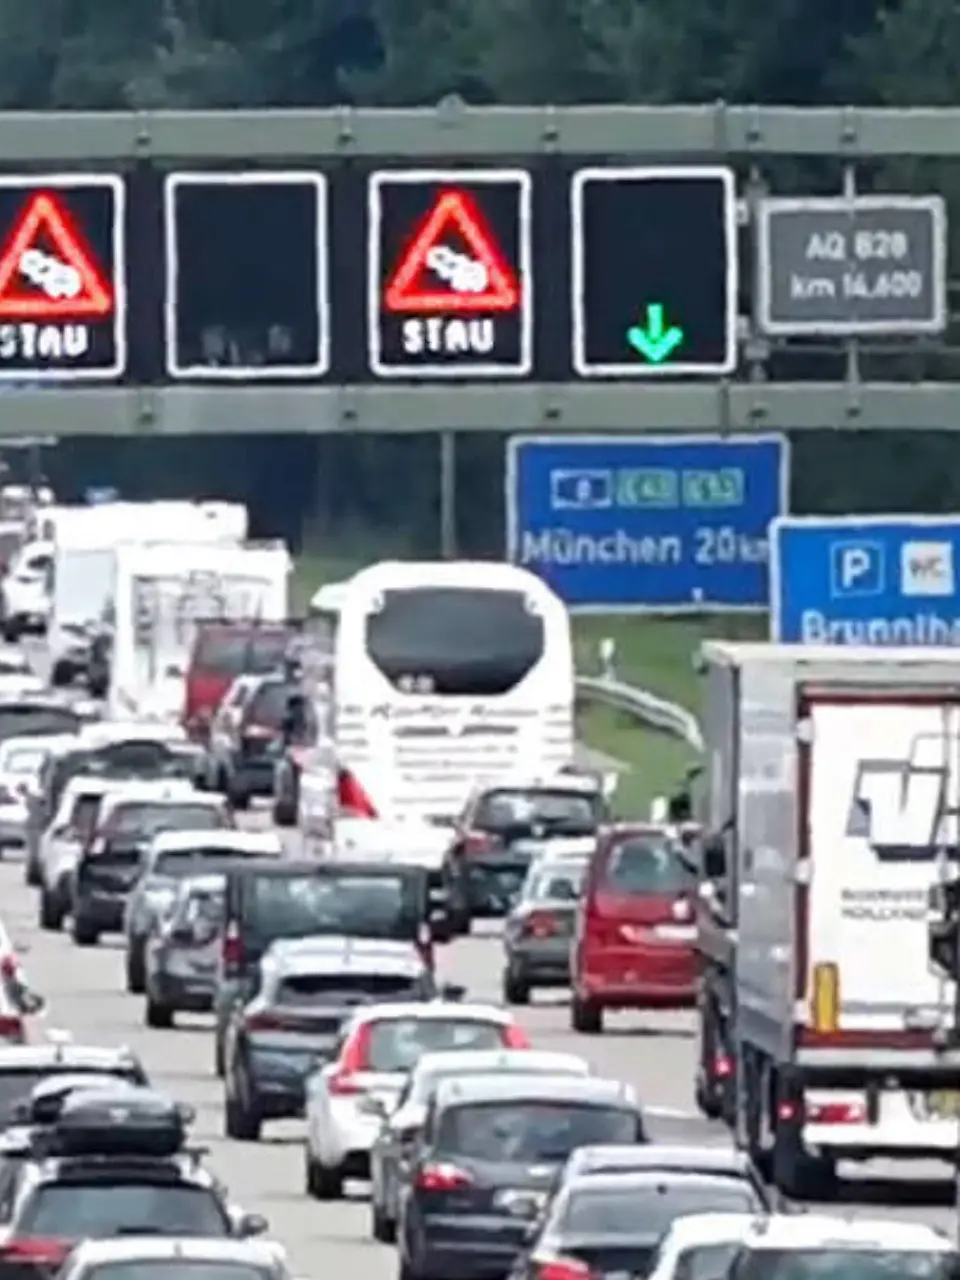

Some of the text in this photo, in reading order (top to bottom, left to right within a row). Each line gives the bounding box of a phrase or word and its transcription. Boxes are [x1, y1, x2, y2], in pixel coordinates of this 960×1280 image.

[790, 272, 837, 299] km
[402, 317, 494, 354] STAU
[521, 527, 683, 566] München
[842, 548, 871, 589] P
